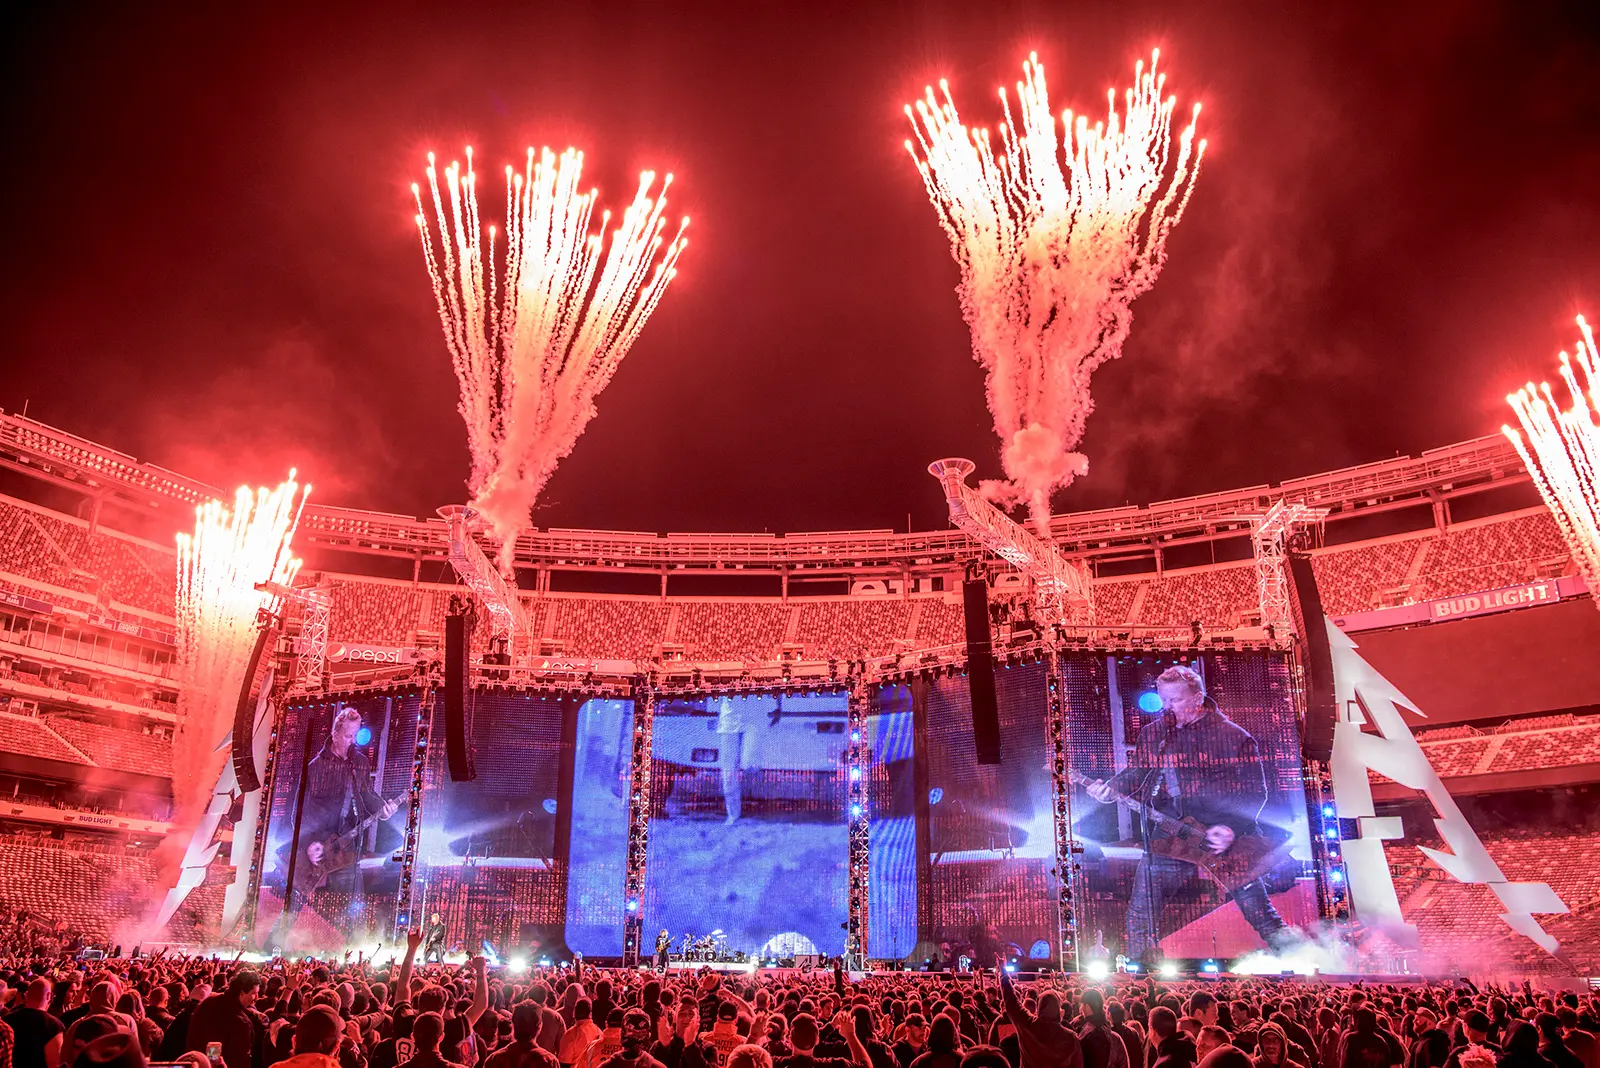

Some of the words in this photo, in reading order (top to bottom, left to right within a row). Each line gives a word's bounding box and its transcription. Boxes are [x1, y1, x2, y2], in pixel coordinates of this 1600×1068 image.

[1435, 597, 1480, 617] BUD
[1483, 584, 1549, 609] LIGHT
[348, 648, 400, 664] pepsi
[79, 815, 93, 823] BUD
[93, 817, 112, 825] LIGHT
